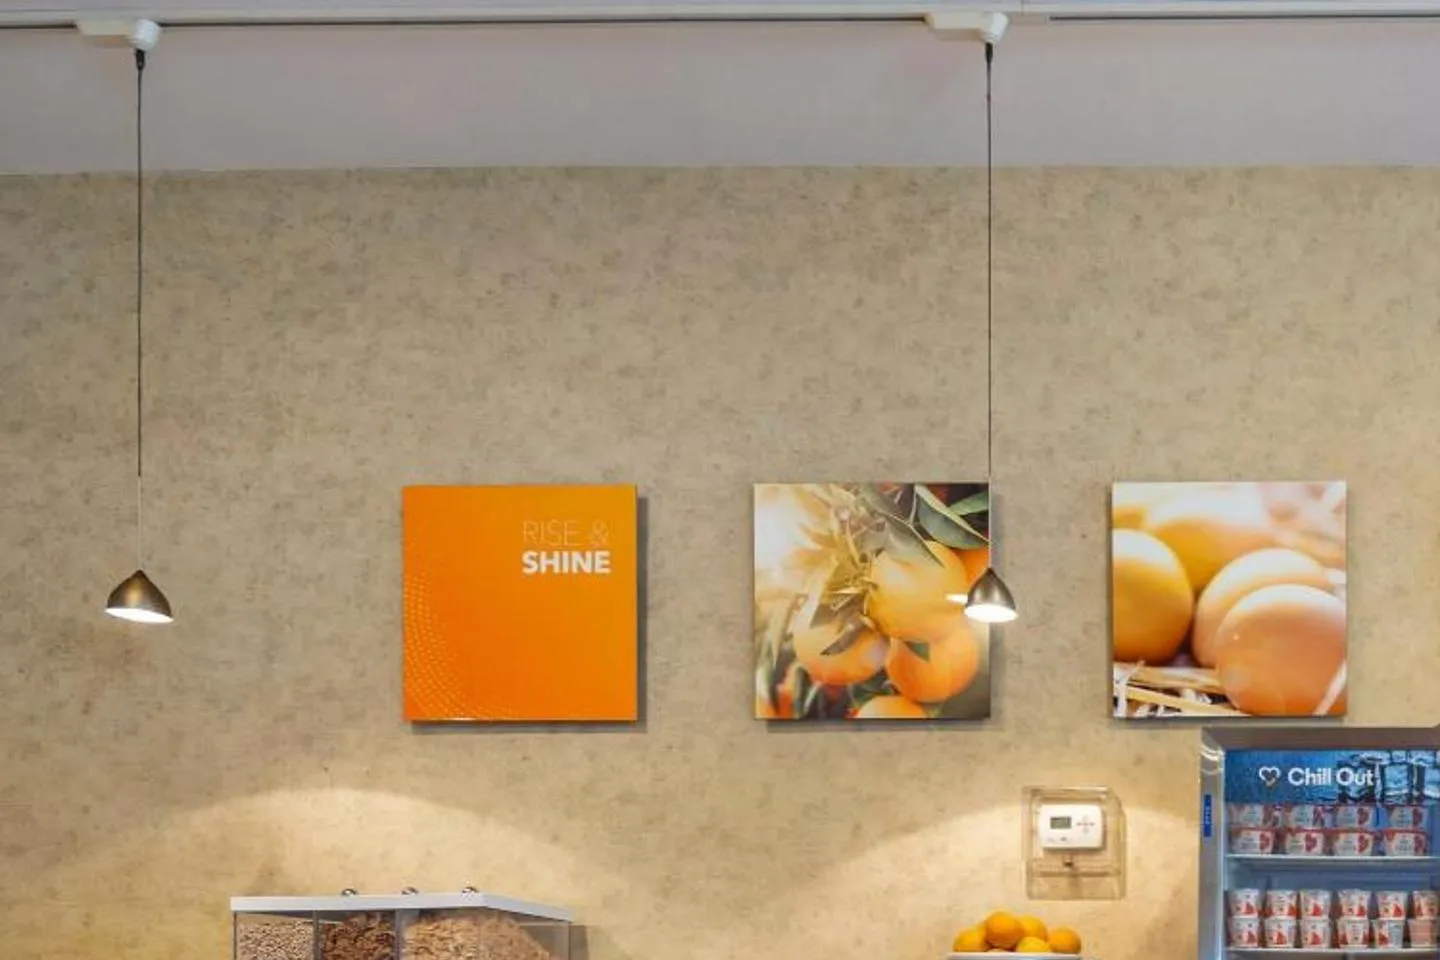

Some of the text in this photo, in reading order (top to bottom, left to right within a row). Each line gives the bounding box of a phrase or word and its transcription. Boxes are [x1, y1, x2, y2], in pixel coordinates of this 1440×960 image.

[522, 550, 611, 574] SHINE
[1288, 767, 1375, 786] Chill Out
